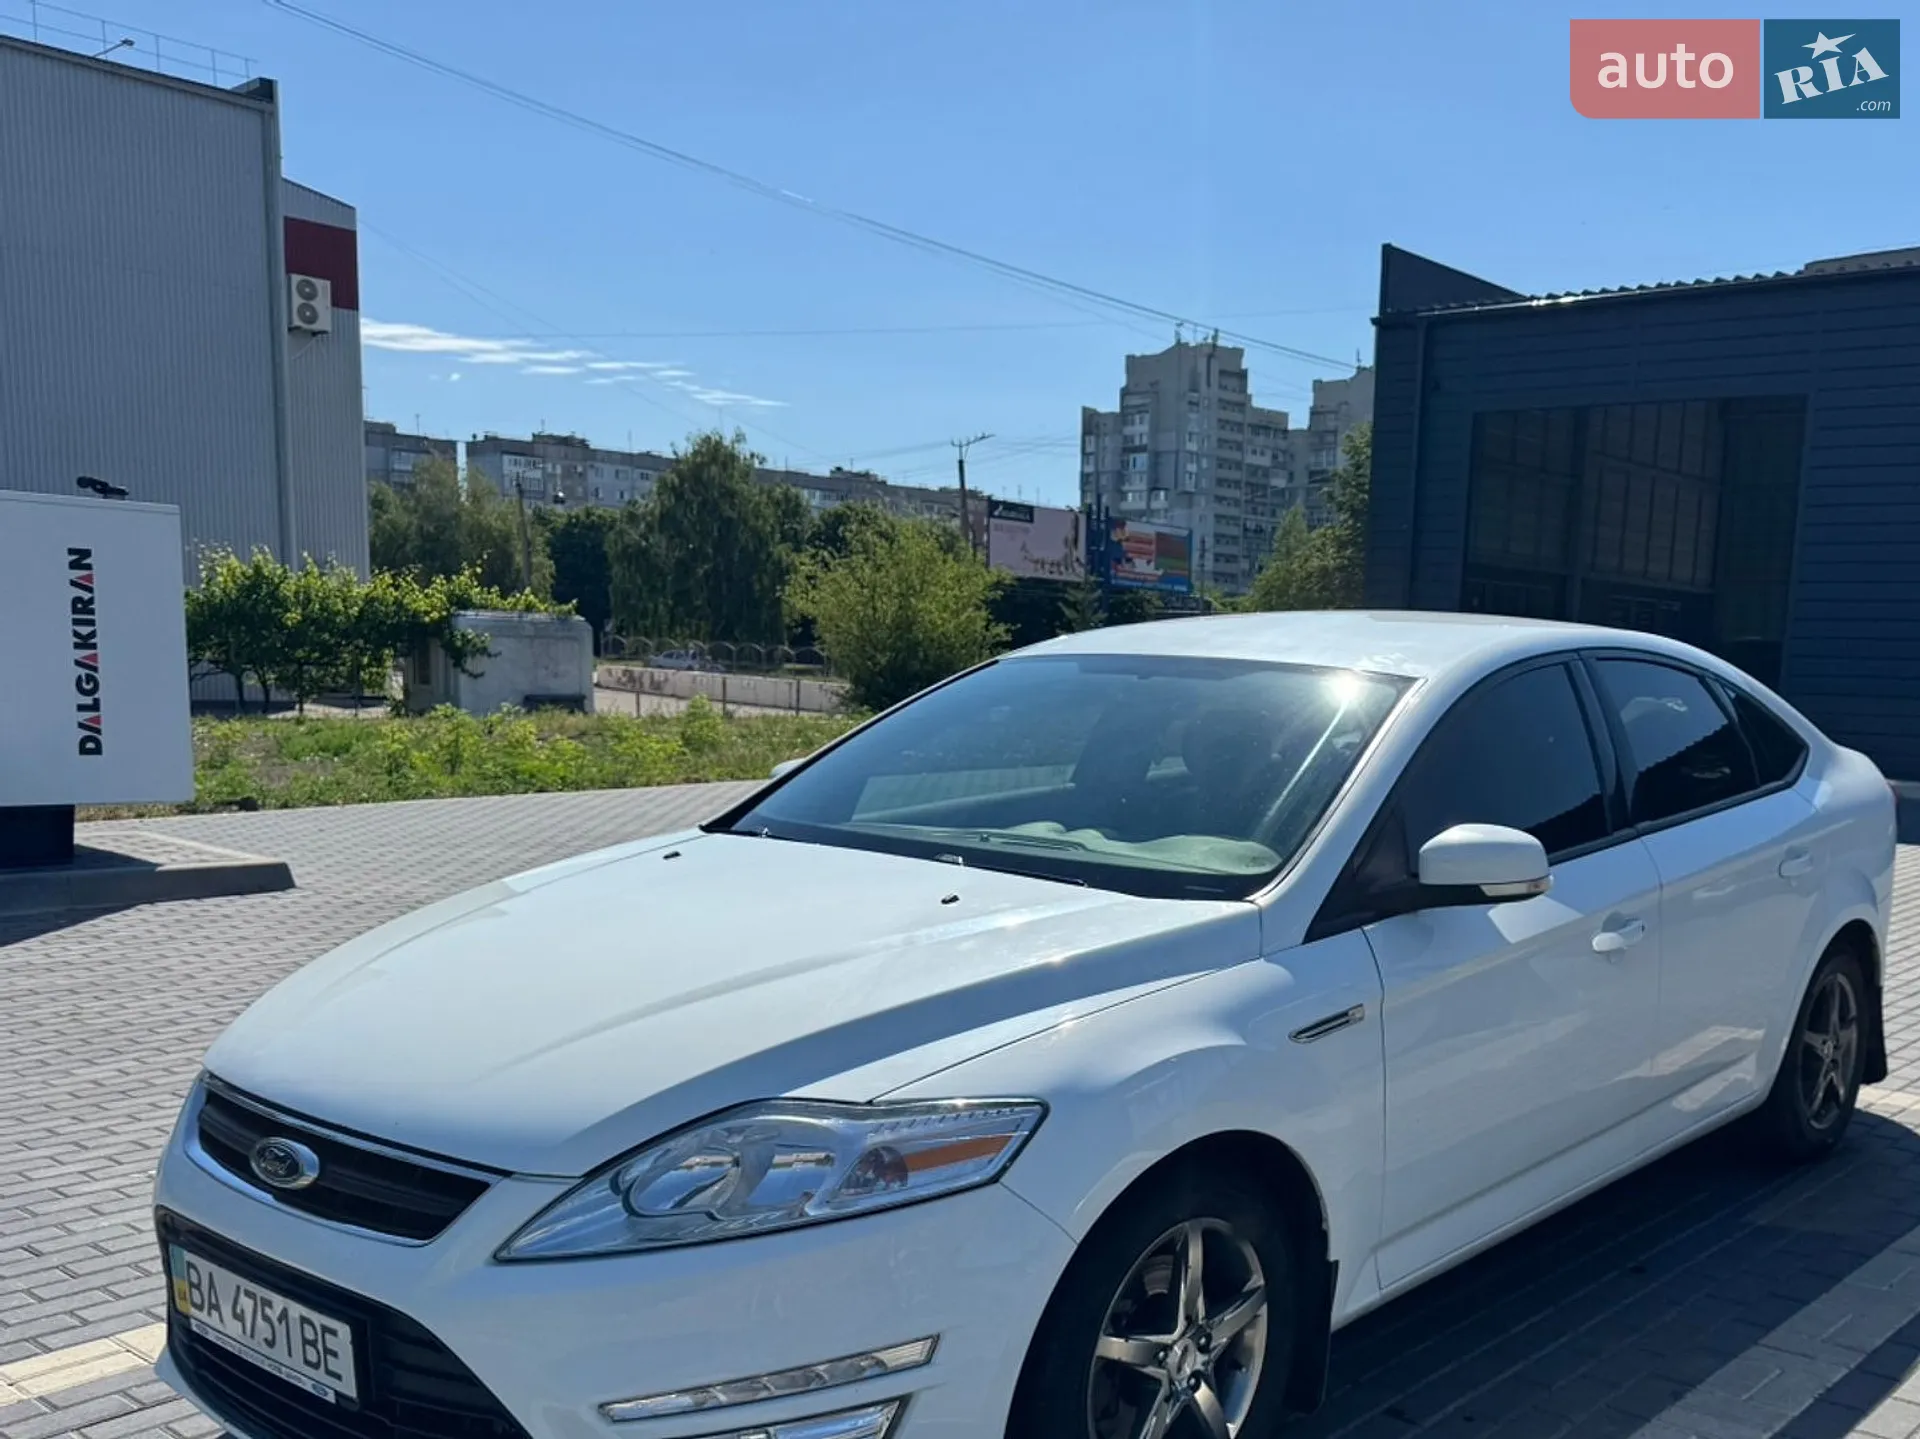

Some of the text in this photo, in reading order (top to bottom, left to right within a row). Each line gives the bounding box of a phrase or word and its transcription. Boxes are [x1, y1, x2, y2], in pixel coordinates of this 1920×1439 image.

[67, 547, 103, 756] DALGAKIRAN
[186, 1260, 224, 1325] BA
[231, 1285, 293, 1359] 4751
[299, 1314, 343, 1382] BE
